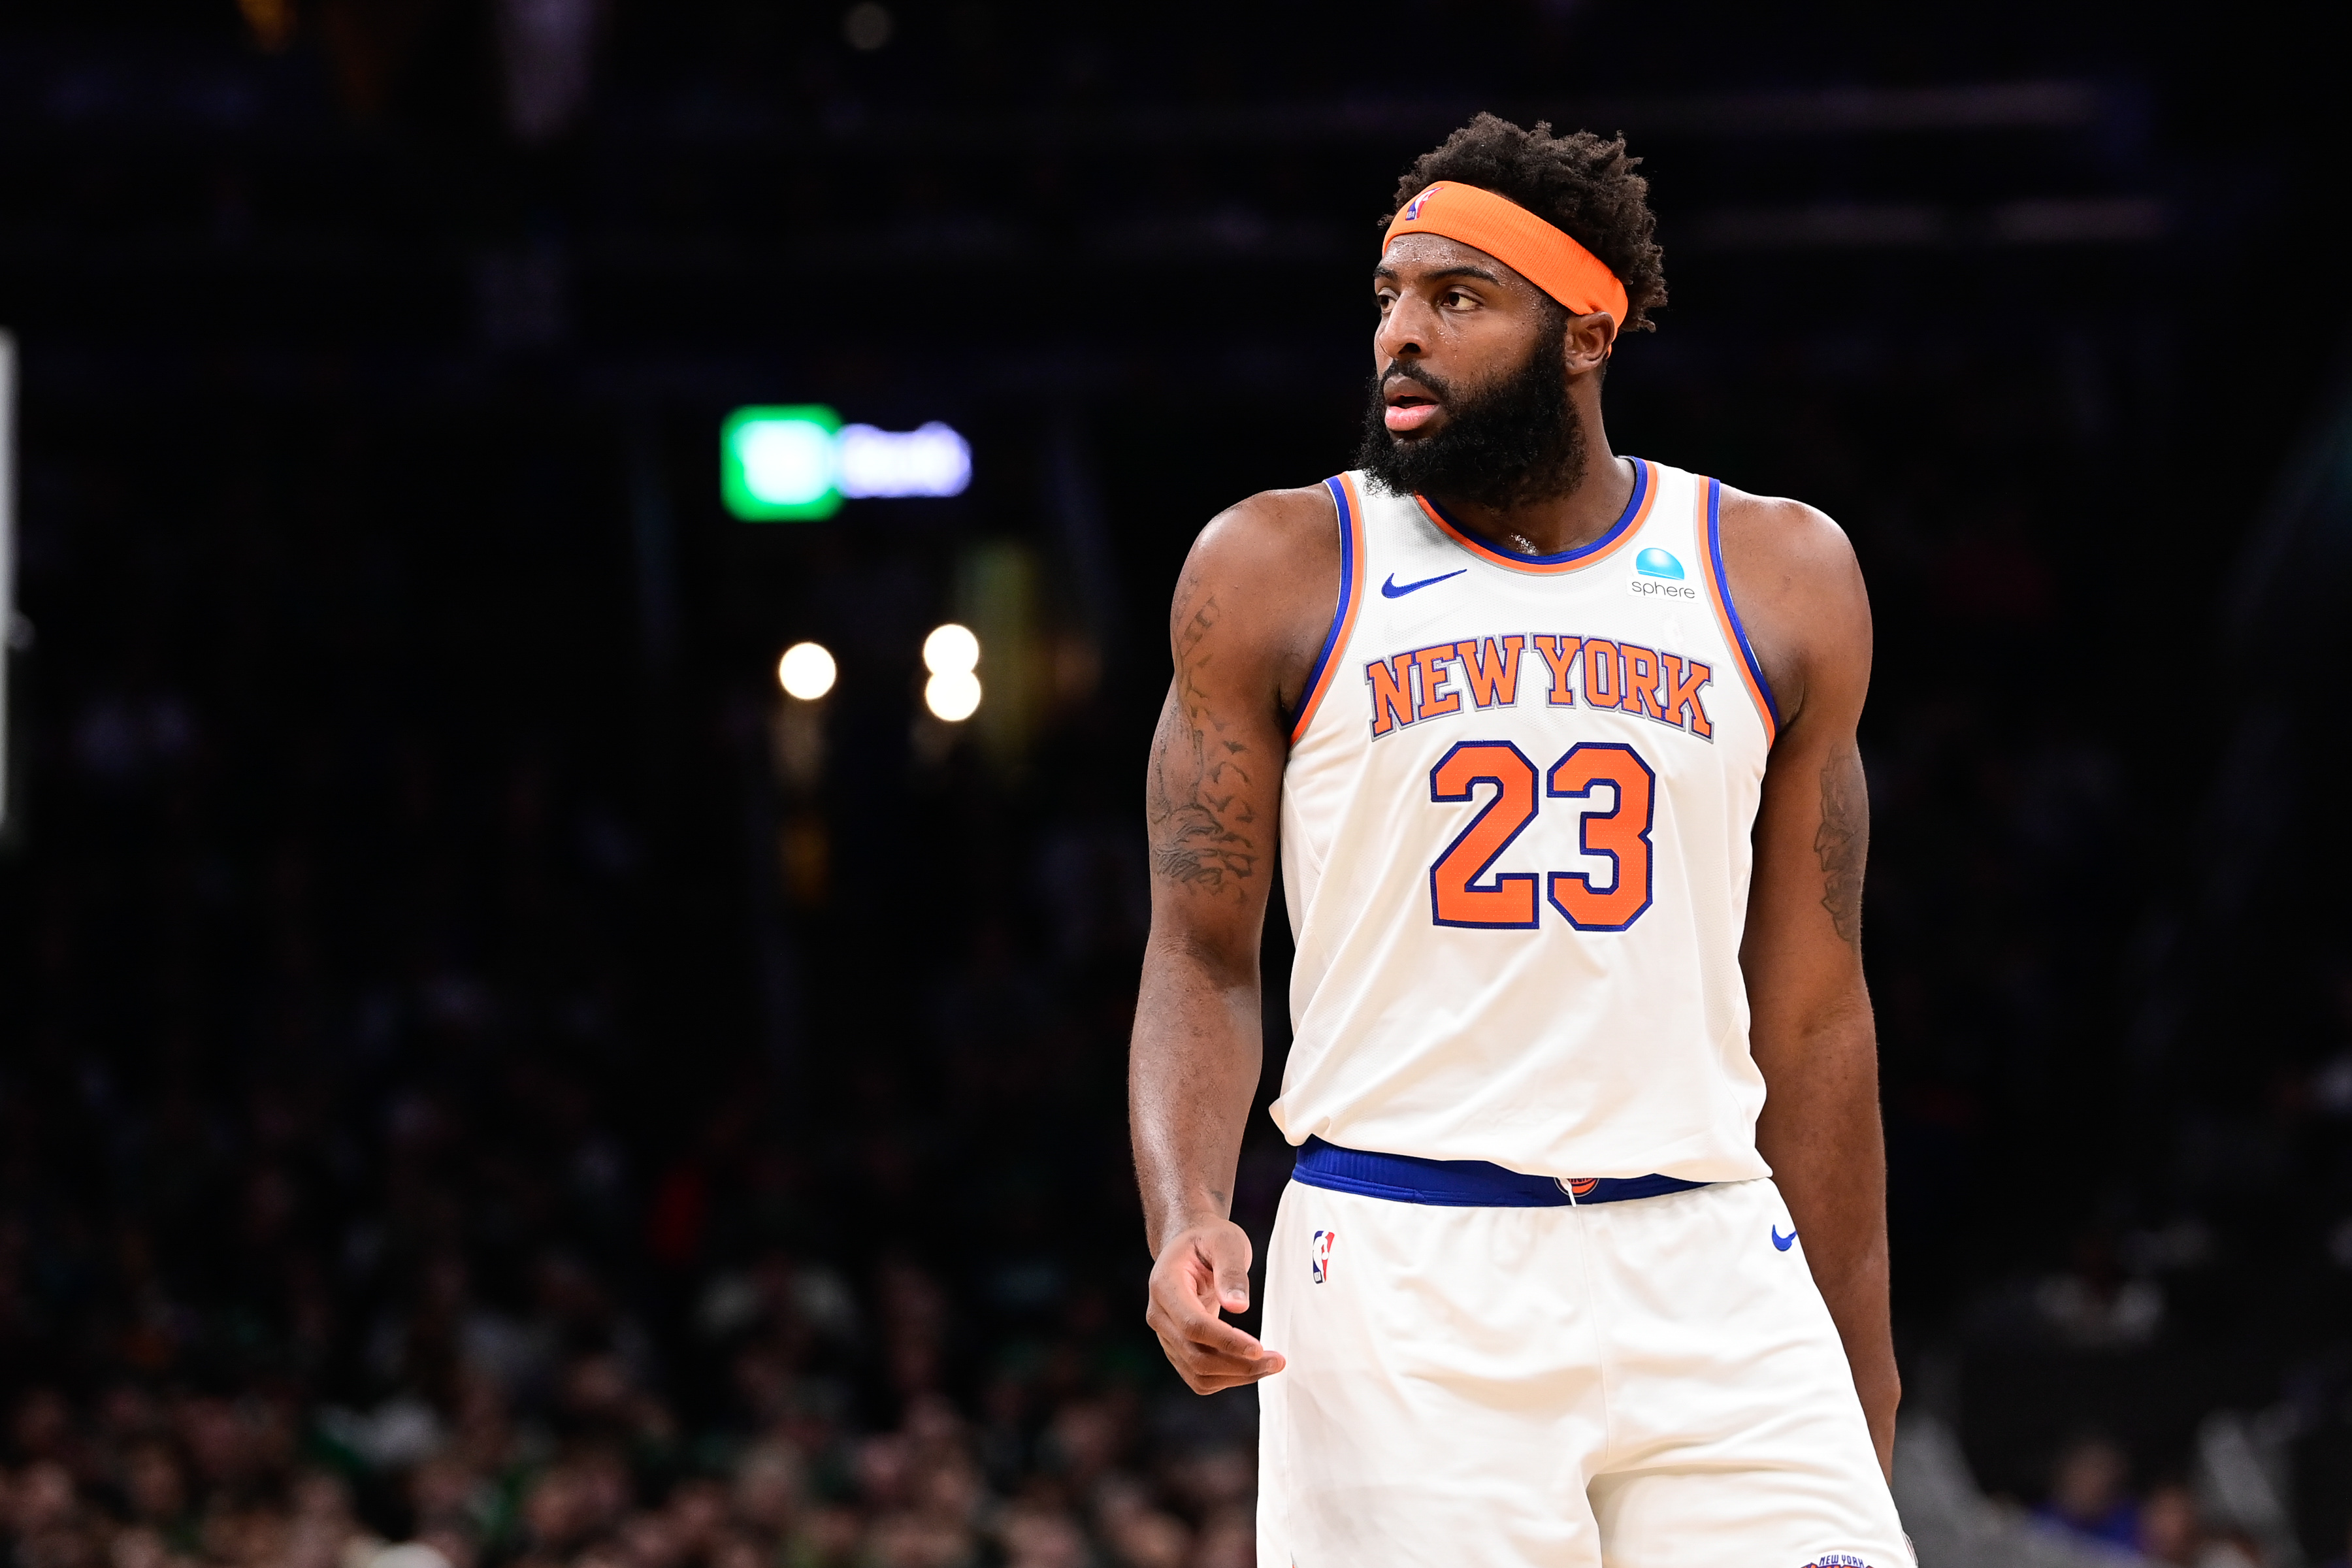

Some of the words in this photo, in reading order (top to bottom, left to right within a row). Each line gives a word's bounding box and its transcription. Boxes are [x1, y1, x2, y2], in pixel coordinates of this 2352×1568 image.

[1631, 581, 1695, 599] sphere
[1365, 632, 1528, 742] NEW
[1529, 632, 1714, 744] YORK
[1429, 740, 1656, 932] 23
[1819, 1554, 1839, 1566] NEW
[1841, 1554, 1865, 1568] YORK
